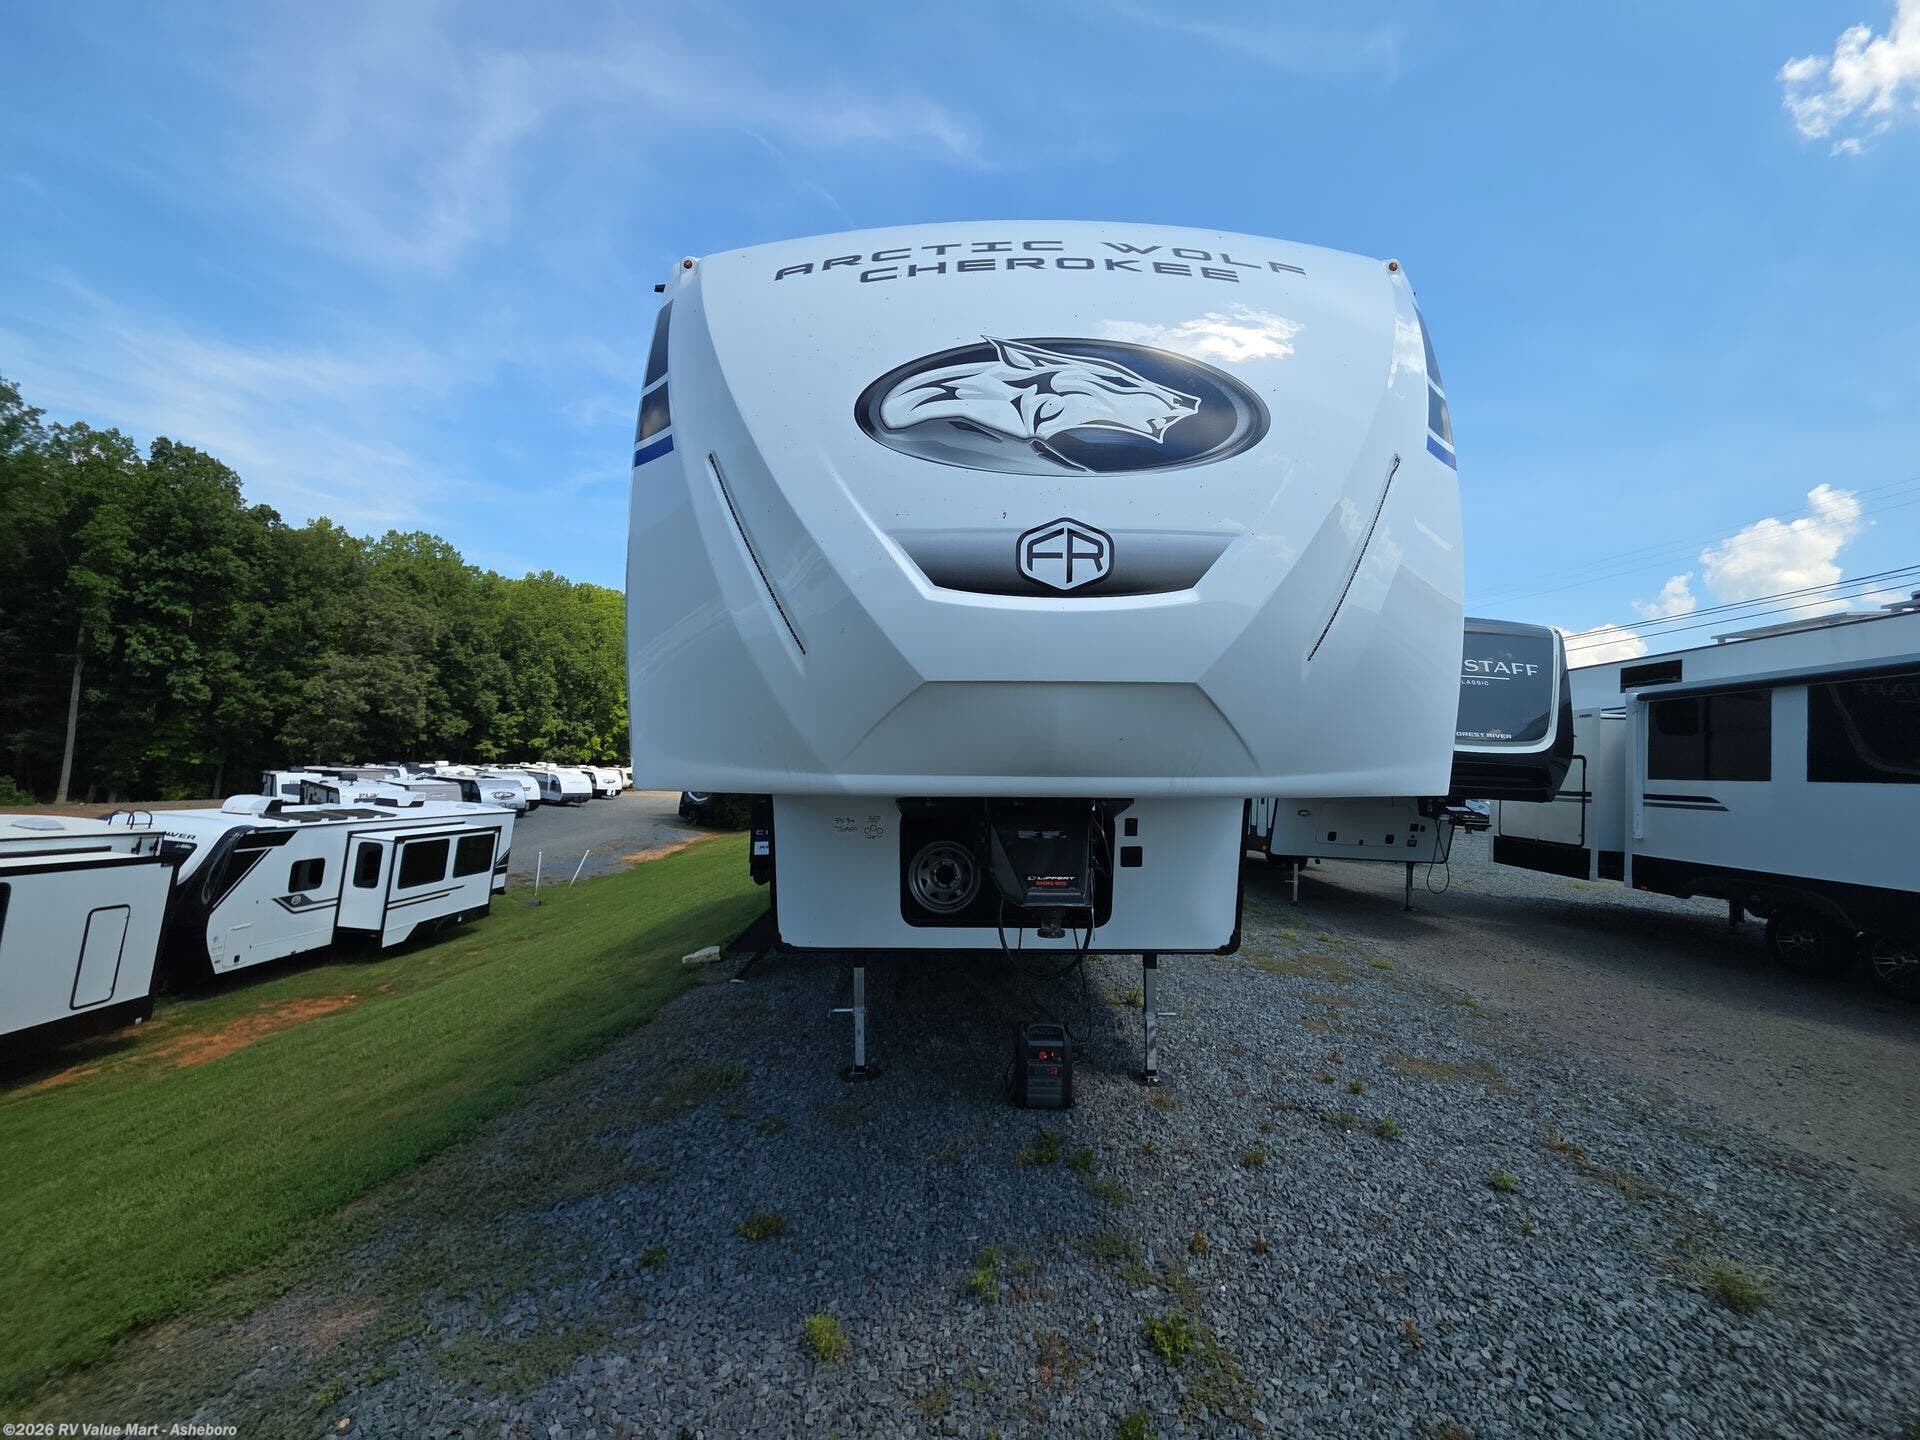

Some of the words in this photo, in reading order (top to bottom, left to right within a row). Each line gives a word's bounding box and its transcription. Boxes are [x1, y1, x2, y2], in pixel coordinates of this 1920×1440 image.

[774, 240, 1064, 281] ARCTIC
[1100, 241, 1307, 276] WOLF
[859, 257, 1240, 284] CHEROKEE
